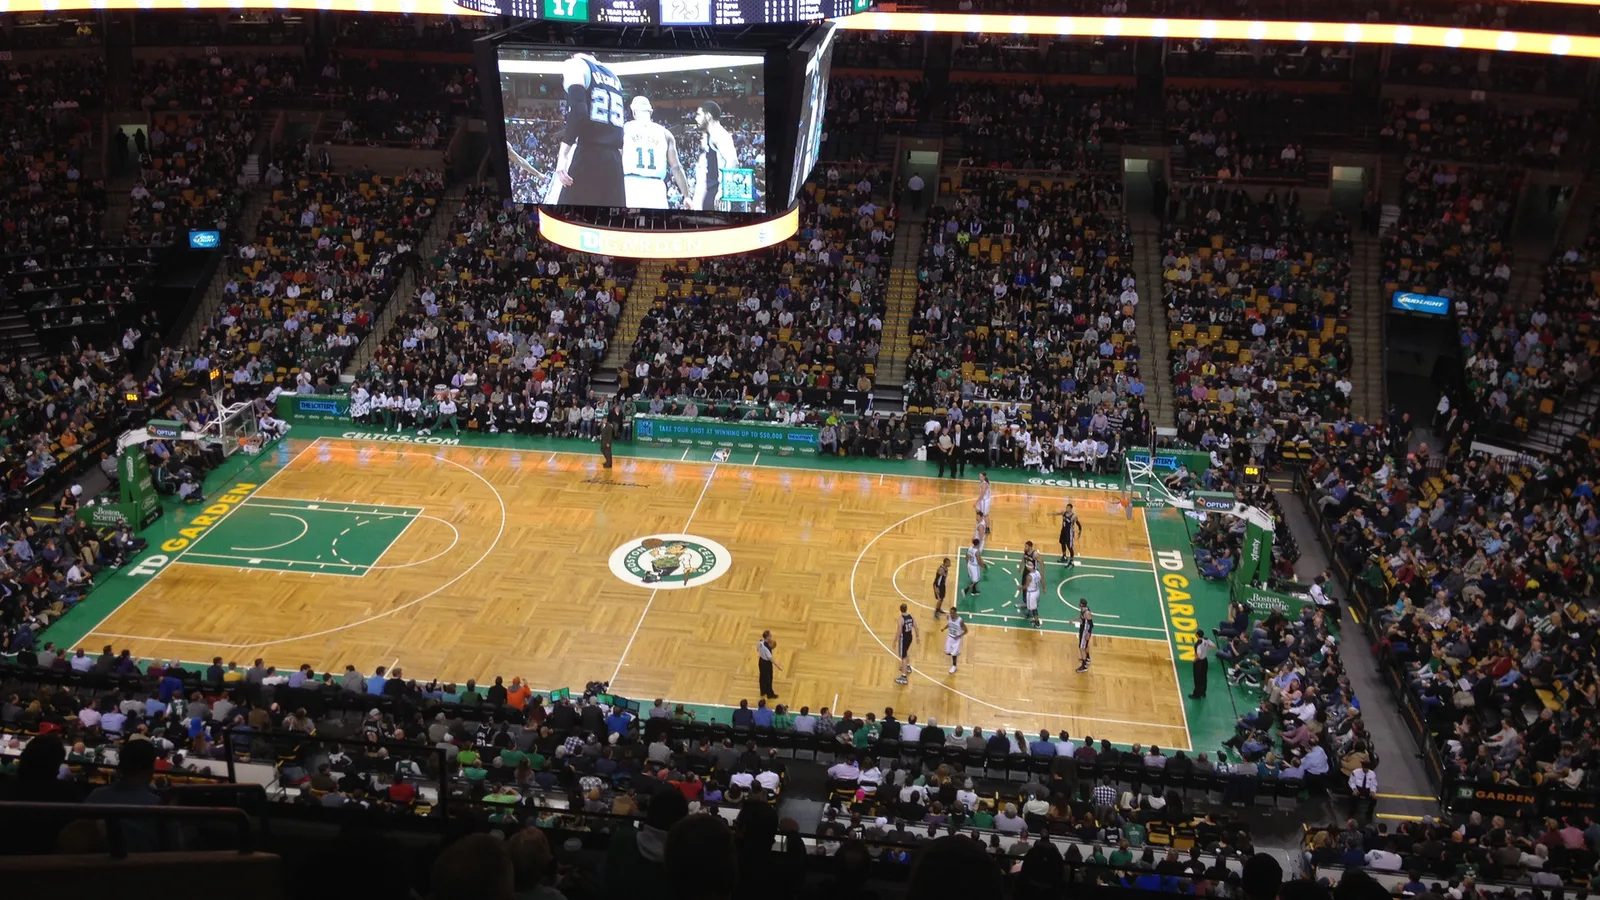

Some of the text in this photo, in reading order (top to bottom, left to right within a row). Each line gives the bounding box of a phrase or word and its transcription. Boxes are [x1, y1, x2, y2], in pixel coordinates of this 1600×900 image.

[553, 0, 577, 16] 17
[590, 87, 624, 128] 25
[636, 147, 656, 170] 11
[605, 235, 702, 252] GARDEN
[342, 432, 460, 446] CELTICS.COM
[1028, 477, 1120, 490] @celtics
[97, 507, 120, 516] Boston
[128, 483, 257, 576] TD GARDEN
[1251, 538, 1260, 561] xfinity
[626, 546, 714, 573] BOSTON CELTICS
[1157, 550, 1198, 662] TD GARDEN
[1252, 593, 1280, 603] Boston
[905, 623, 912, 632] 15
[1460, 788, 1535, 803] TD GARDEN
